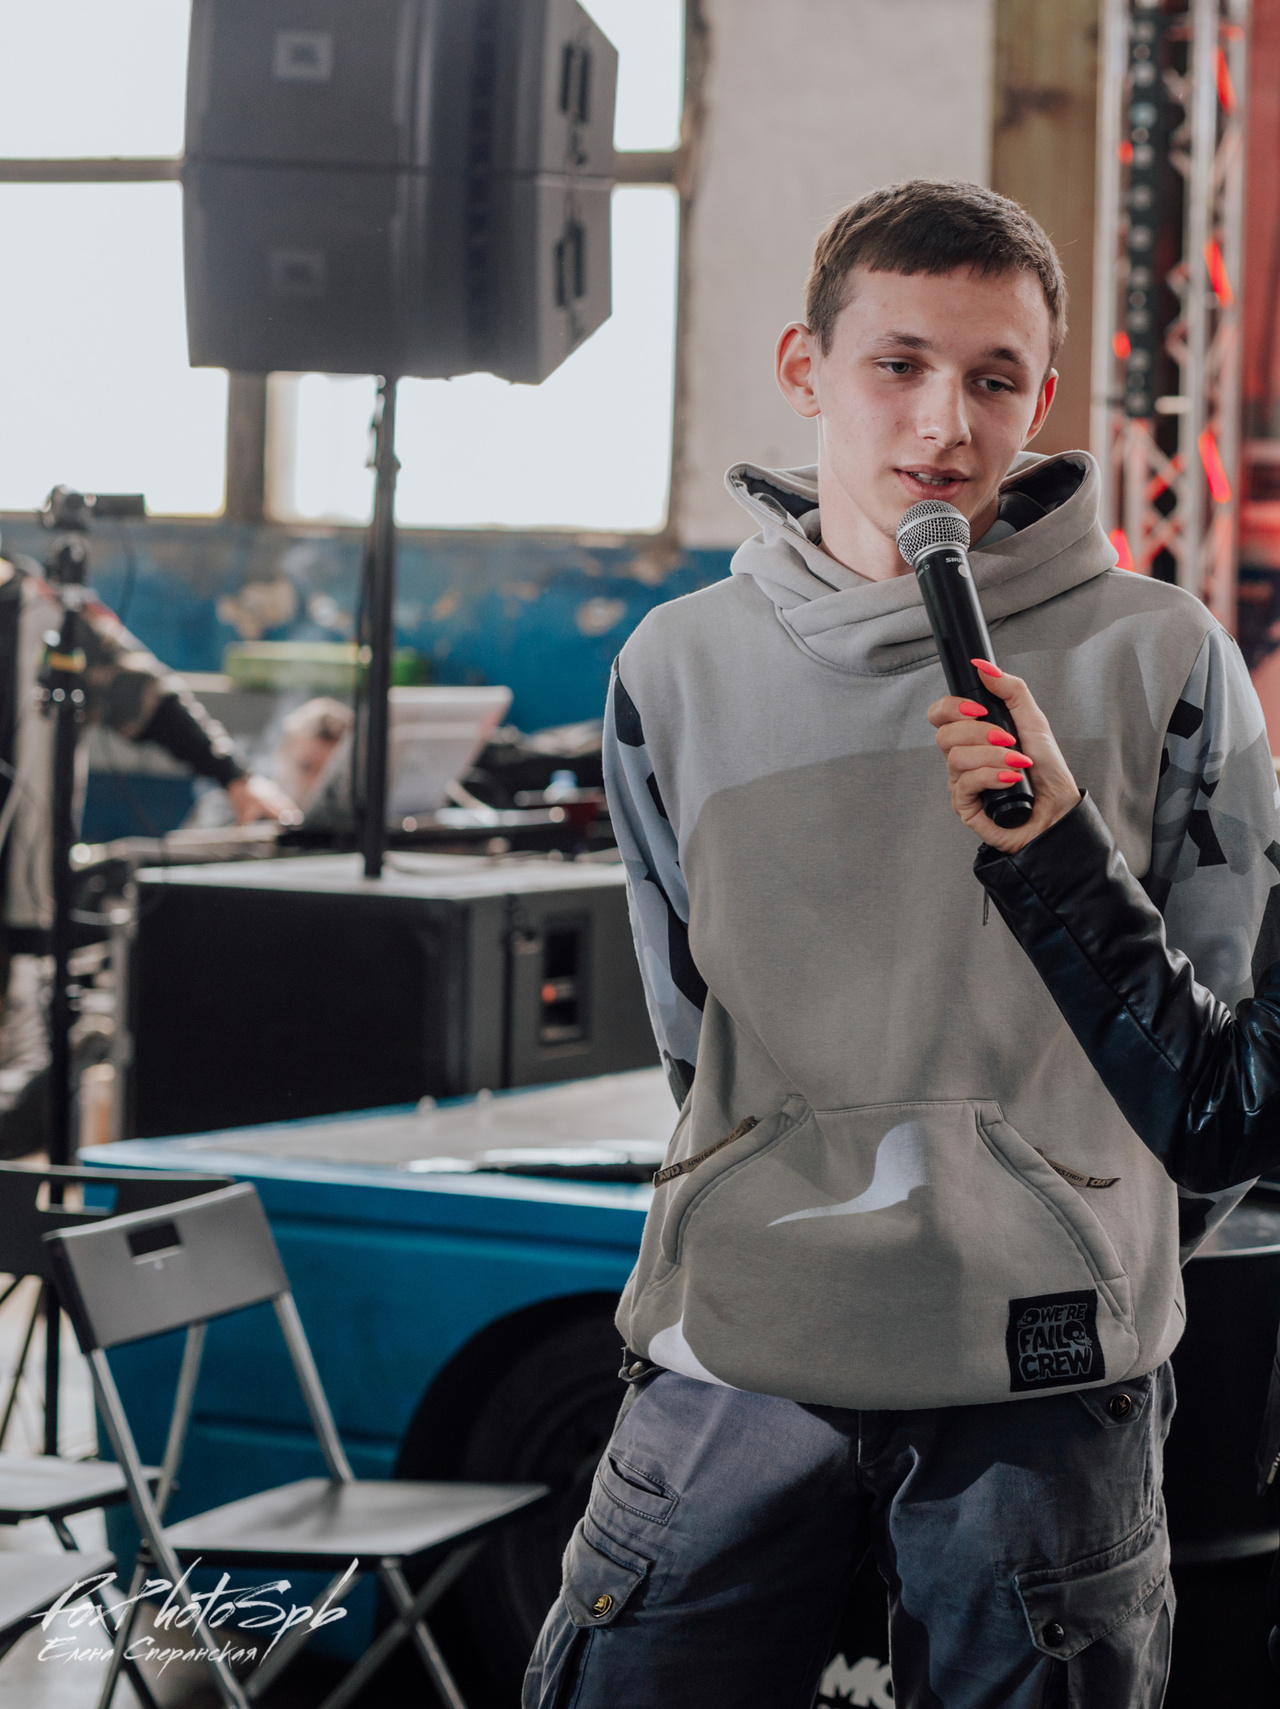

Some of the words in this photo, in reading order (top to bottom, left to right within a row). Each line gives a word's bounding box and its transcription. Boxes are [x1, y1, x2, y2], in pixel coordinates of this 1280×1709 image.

[1040, 1303, 1088, 1323] WE'RE
[1018, 1324, 1072, 1355] FAIL
[1019, 1347, 1093, 1381] CREW
